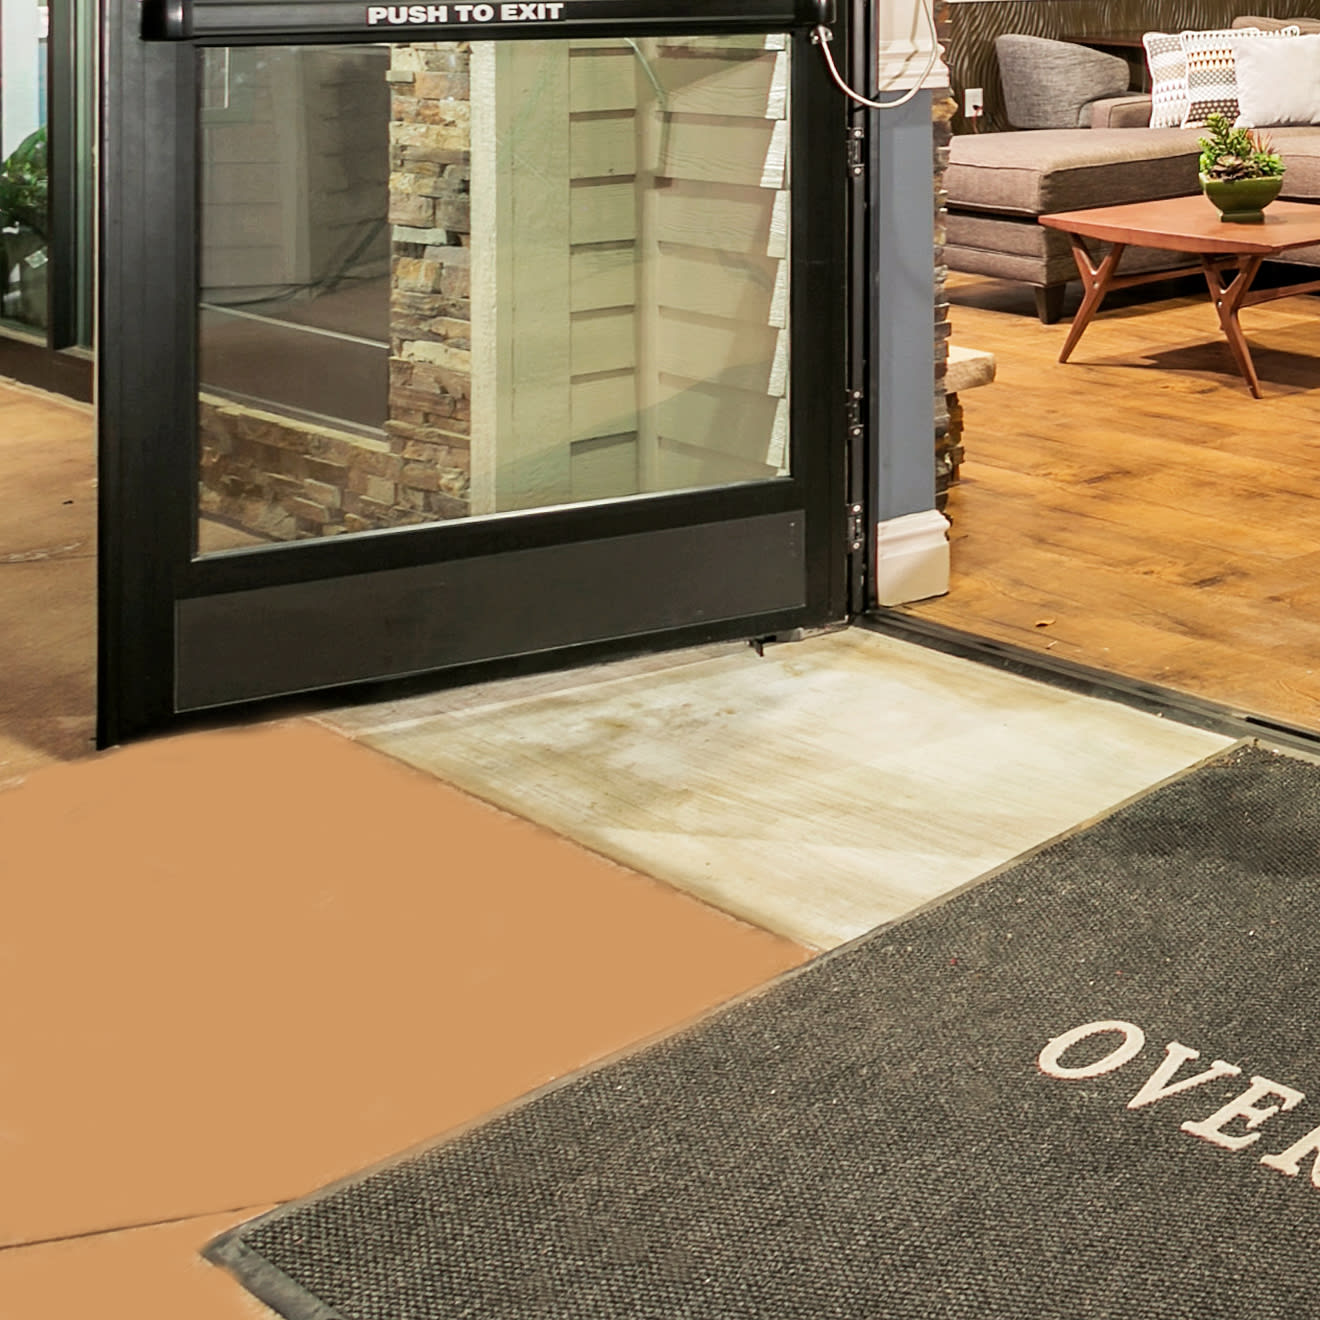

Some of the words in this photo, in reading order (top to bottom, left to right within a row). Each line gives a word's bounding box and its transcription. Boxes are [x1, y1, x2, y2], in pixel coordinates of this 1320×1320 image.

[367, 5, 448, 24] PUSH
[454, 4, 495, 22] TO
[501, 2, 564, 21] EXIT
